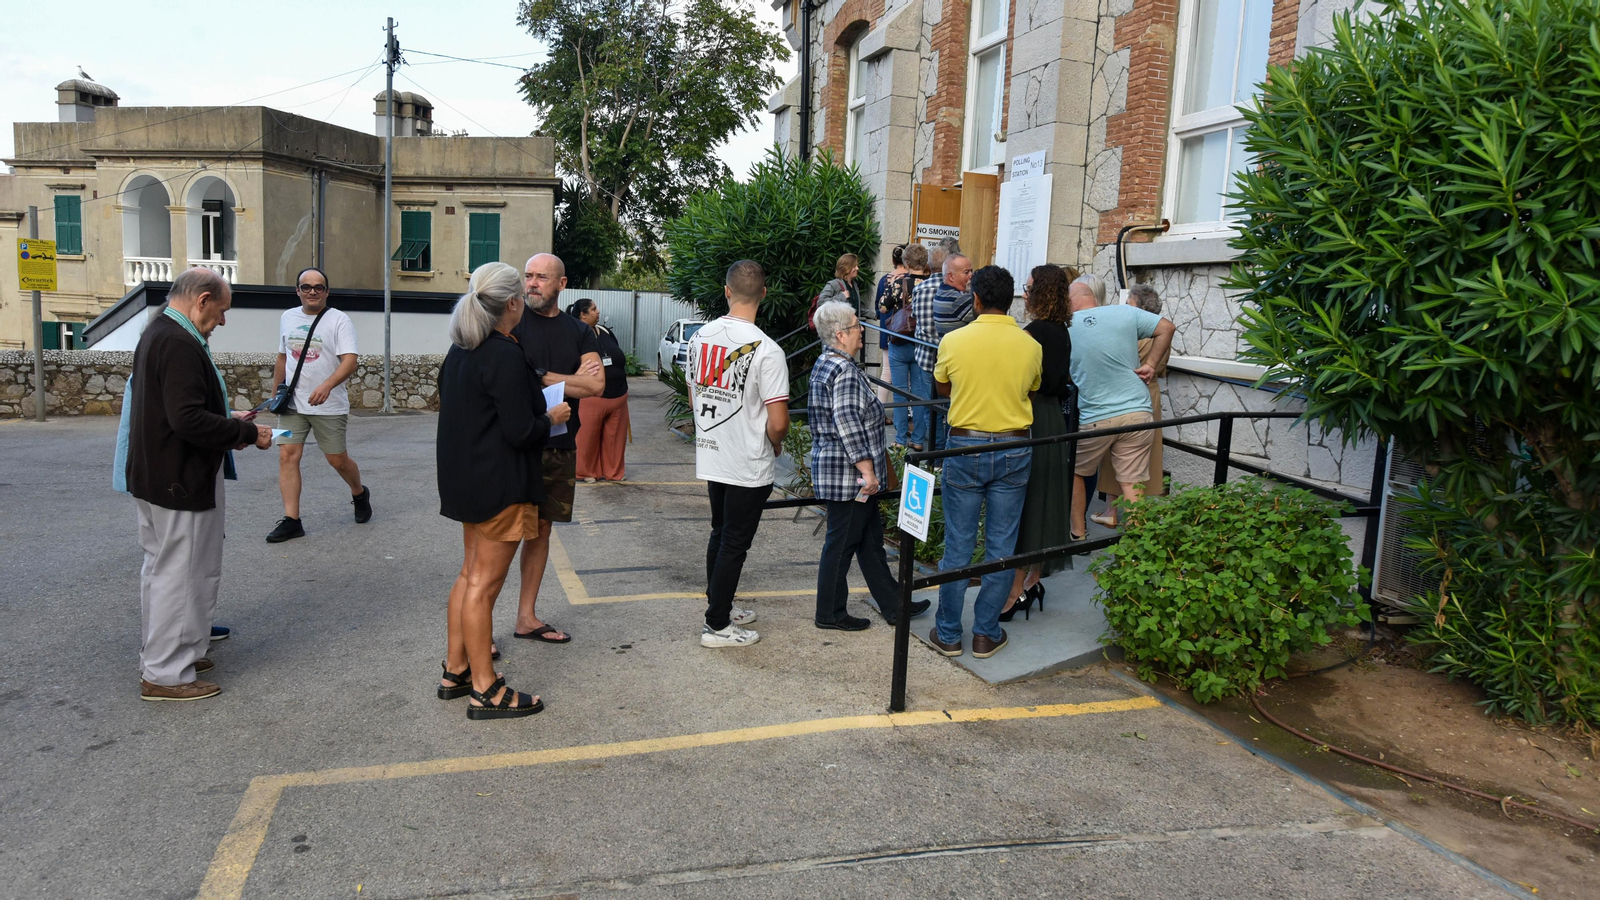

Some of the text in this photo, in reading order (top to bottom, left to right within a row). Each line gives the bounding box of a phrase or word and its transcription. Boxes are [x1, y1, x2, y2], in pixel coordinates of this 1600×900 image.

[1013, 157, 1030, 166] POLLING
[1012, 169, 1028, 178] STATION
[928, 228, 959, 237] SMOKING
[709, 389, 737, 399] OPENING
[904, 512, 922, 524] WHEELCHAIR
[907, 520, 918, 529] ACCESS
